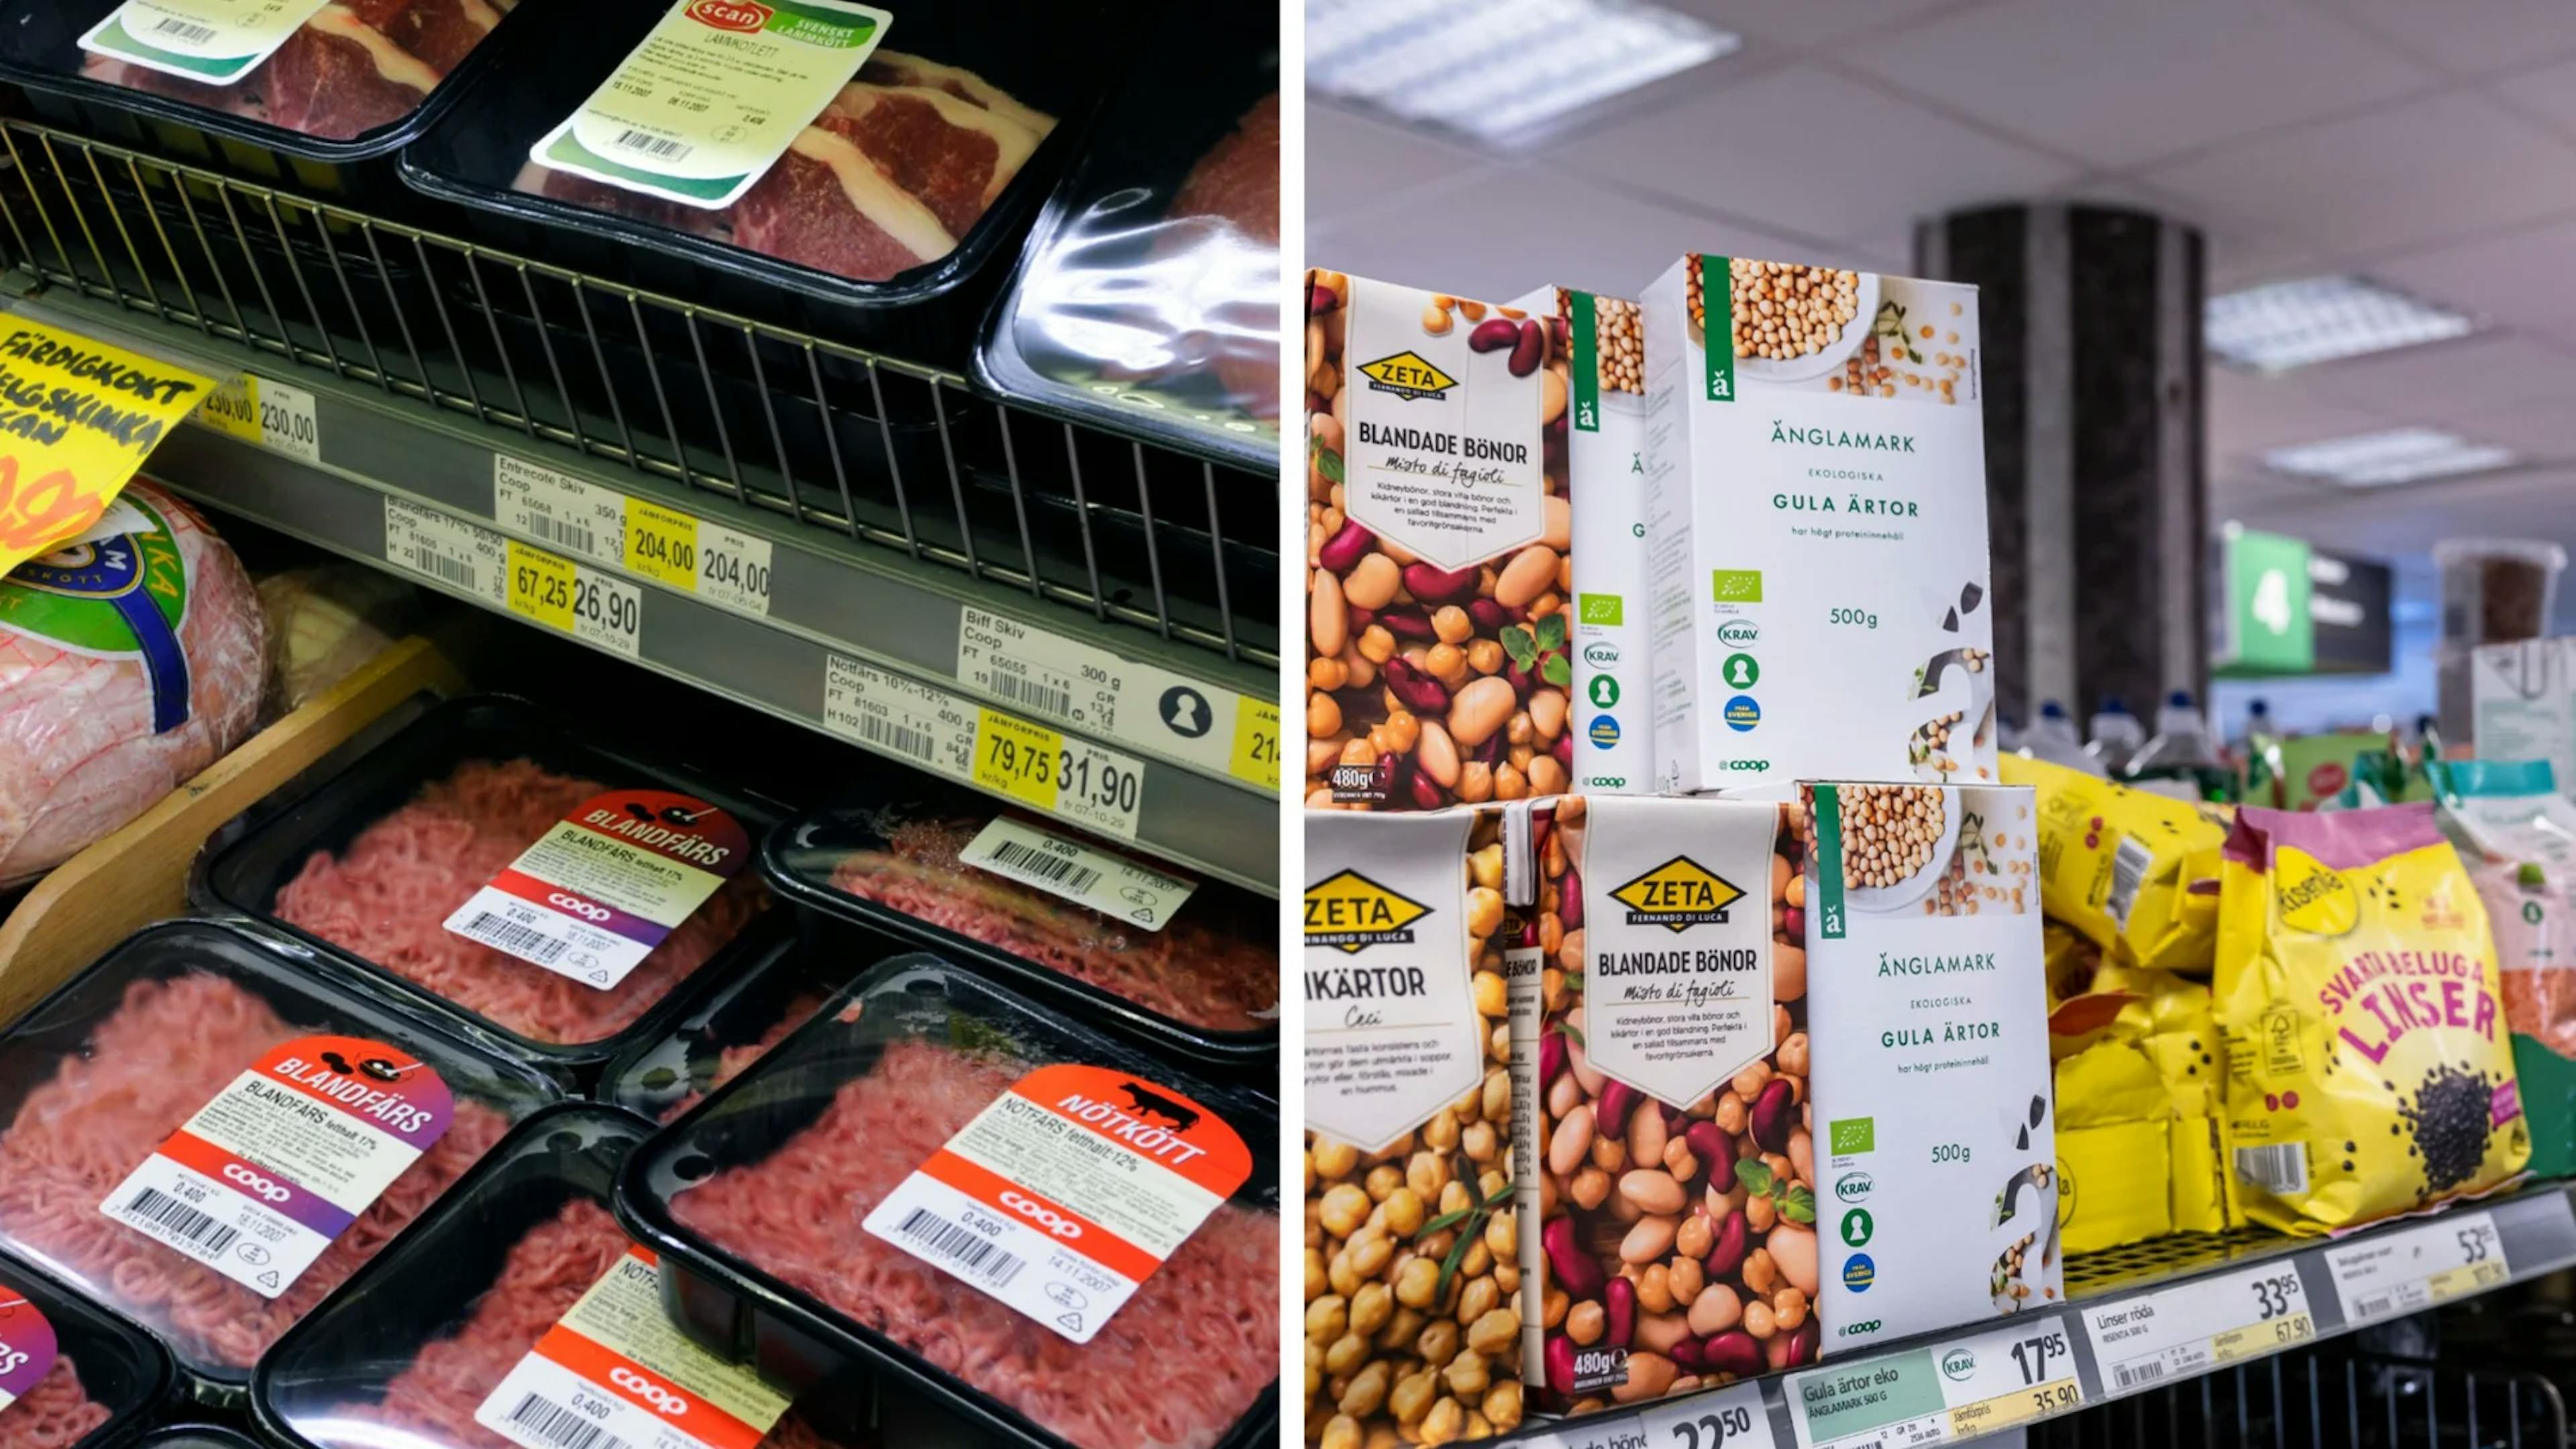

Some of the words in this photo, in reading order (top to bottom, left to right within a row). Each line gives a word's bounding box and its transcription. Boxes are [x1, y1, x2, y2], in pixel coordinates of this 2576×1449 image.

[701, 2, 755, 24] scan
[776, 25, 849, 48] LAMMKÖTT
[797, 19, 855, 38] SVENSKT
[0, 331, 196, 405] FÄRDIGKOKT
[1379, 363, 1436, 388] ZETA
[260, 401, 314, 444] 230,00
[1358, 421, 1458, 455] BLANDADE
[1464, 437, 1527, 465] BÖNOR
[499, 472, 531, 493] Coop
[500, 458, 555, 486] Entrecote
[559, 477, 585, 495] Skiv
[1432, 460, 1449, 476] di
[1451, 462, 1505, 488] fagioli
[1808, 468, 1884, 482] EKOLOGISKA
[500, 488, 512, 501] FT
[1773, 493, 1836, 513] GULA
[1847, 493, 1919, 517] ÄRTOR
[387, 508, 417, 529] Coop
[516, 514, 528, 525] 12
[596, 504, 616, 521] 350
[724, 535, 745, 549] PRIS
[1791, 526, 1808, 536] har
[635, 528, 694, 572] 204,00
[704, 548, 770, 598] 204,00
[517, 566, 568, 609] 67,25
[573, 577, 637, 635] 26,90
[2251, 568, 2291, 635] 4
[967, 609, 991, 629] Biff
[994, 619, 1025, 640] Skiv
[1722, 629, 1758, 641] KRAV
[963, 626, 1002, 650] Coop
[963, 645, 979, 659] FT
[989, 654, 1028, 676] 65055
[1589, 649, 1619, 662] KRAV
[828, 671, 865, 694] Coop
[973, 671, 988, 685] 19
[1081, 664, 1107, 684] 300
[1111, 677, 1122, 692] g
[828, 688, 843, 701] FT
[853, 696, 888, 717] 81603
[938, 709, 962, 727] 400
[965, 720, 976, 735] g
[989, 733, 1050, 784] 79,75
[1085, 748, 1110, 762] PRIS
[1250, 732, 1280, 763] 21
[1729, 759, 1770, 773] coop
[1057, 750, 1136, 814] 31,90
[1591, 775, 1626, 789] coop
[1074, 802, 1126, 829] 07-10-29
[560, 829, 637, 863] BLANDFÄRS
[583, 809, 730, 866] BLANDFÄRS
[1642, 881, 1715, 906] ZETA
[548, 892, 611, 922] coop
[1632, 914, 1683, 923] FERNANDO
[1685, 914, 1696, 922] DI
[1698, 913, 1723, 922] LUCA
[1599, 951, 1690, 977] BLANDADE
[1696, 949, 1758, 973] BÖNOR
[1304, 967, 1427, 1002] IKÄRTOR
[1666, 981, 1683, 999] di
[1685, 979, 1735, 1008] fagioli
[1344, 1004, 1382, 1028] Ceci
[1910, 996, 1973, 1010] EKOLOGISKA
[1881, 1028, 1935, 1049] GULA
[1943, 1021, 2000, 1043] ÄRTOR
[2339, 981, 2497, 1065] LINSER
[1897, 1064, 1913, 1074] har
[245, 1080, 328, 1124] BLANDFÄRS
[273, 1057, 433, 1133] BLANDFÄRS
[1002, 1097, 1067, 1134] NÖTFÄRS
[1057, 1093, 1208, 1165] NÖTKÖTT
[223, 1163, 291, 1203] coop
[1839, 1179, 1872, 1196] KRAV
[998, 1190, 1082, 1238] coop
[1847, 1318, 1882, 1336] coop
[2096, 1311, 2128, 1330] Linser
[2129, 1304, 2155, 1321] röda
[2275, 1316, 2312, 1342] 67.90
[1574, 1351, 1610, 1375] 480g
[1946, 1357, 1974, 1375] KRAV
[609, 1366, 688, 1415] coop
[1803, 1382, 1836, 1403] Gula
[1837, 1376, 1872, 1395] ärtor
[1874, 1366, 1899, 1385] eko
[1864, 1393, 1879, 1405] 500
[1879, 1390, 1888, 1401] G
